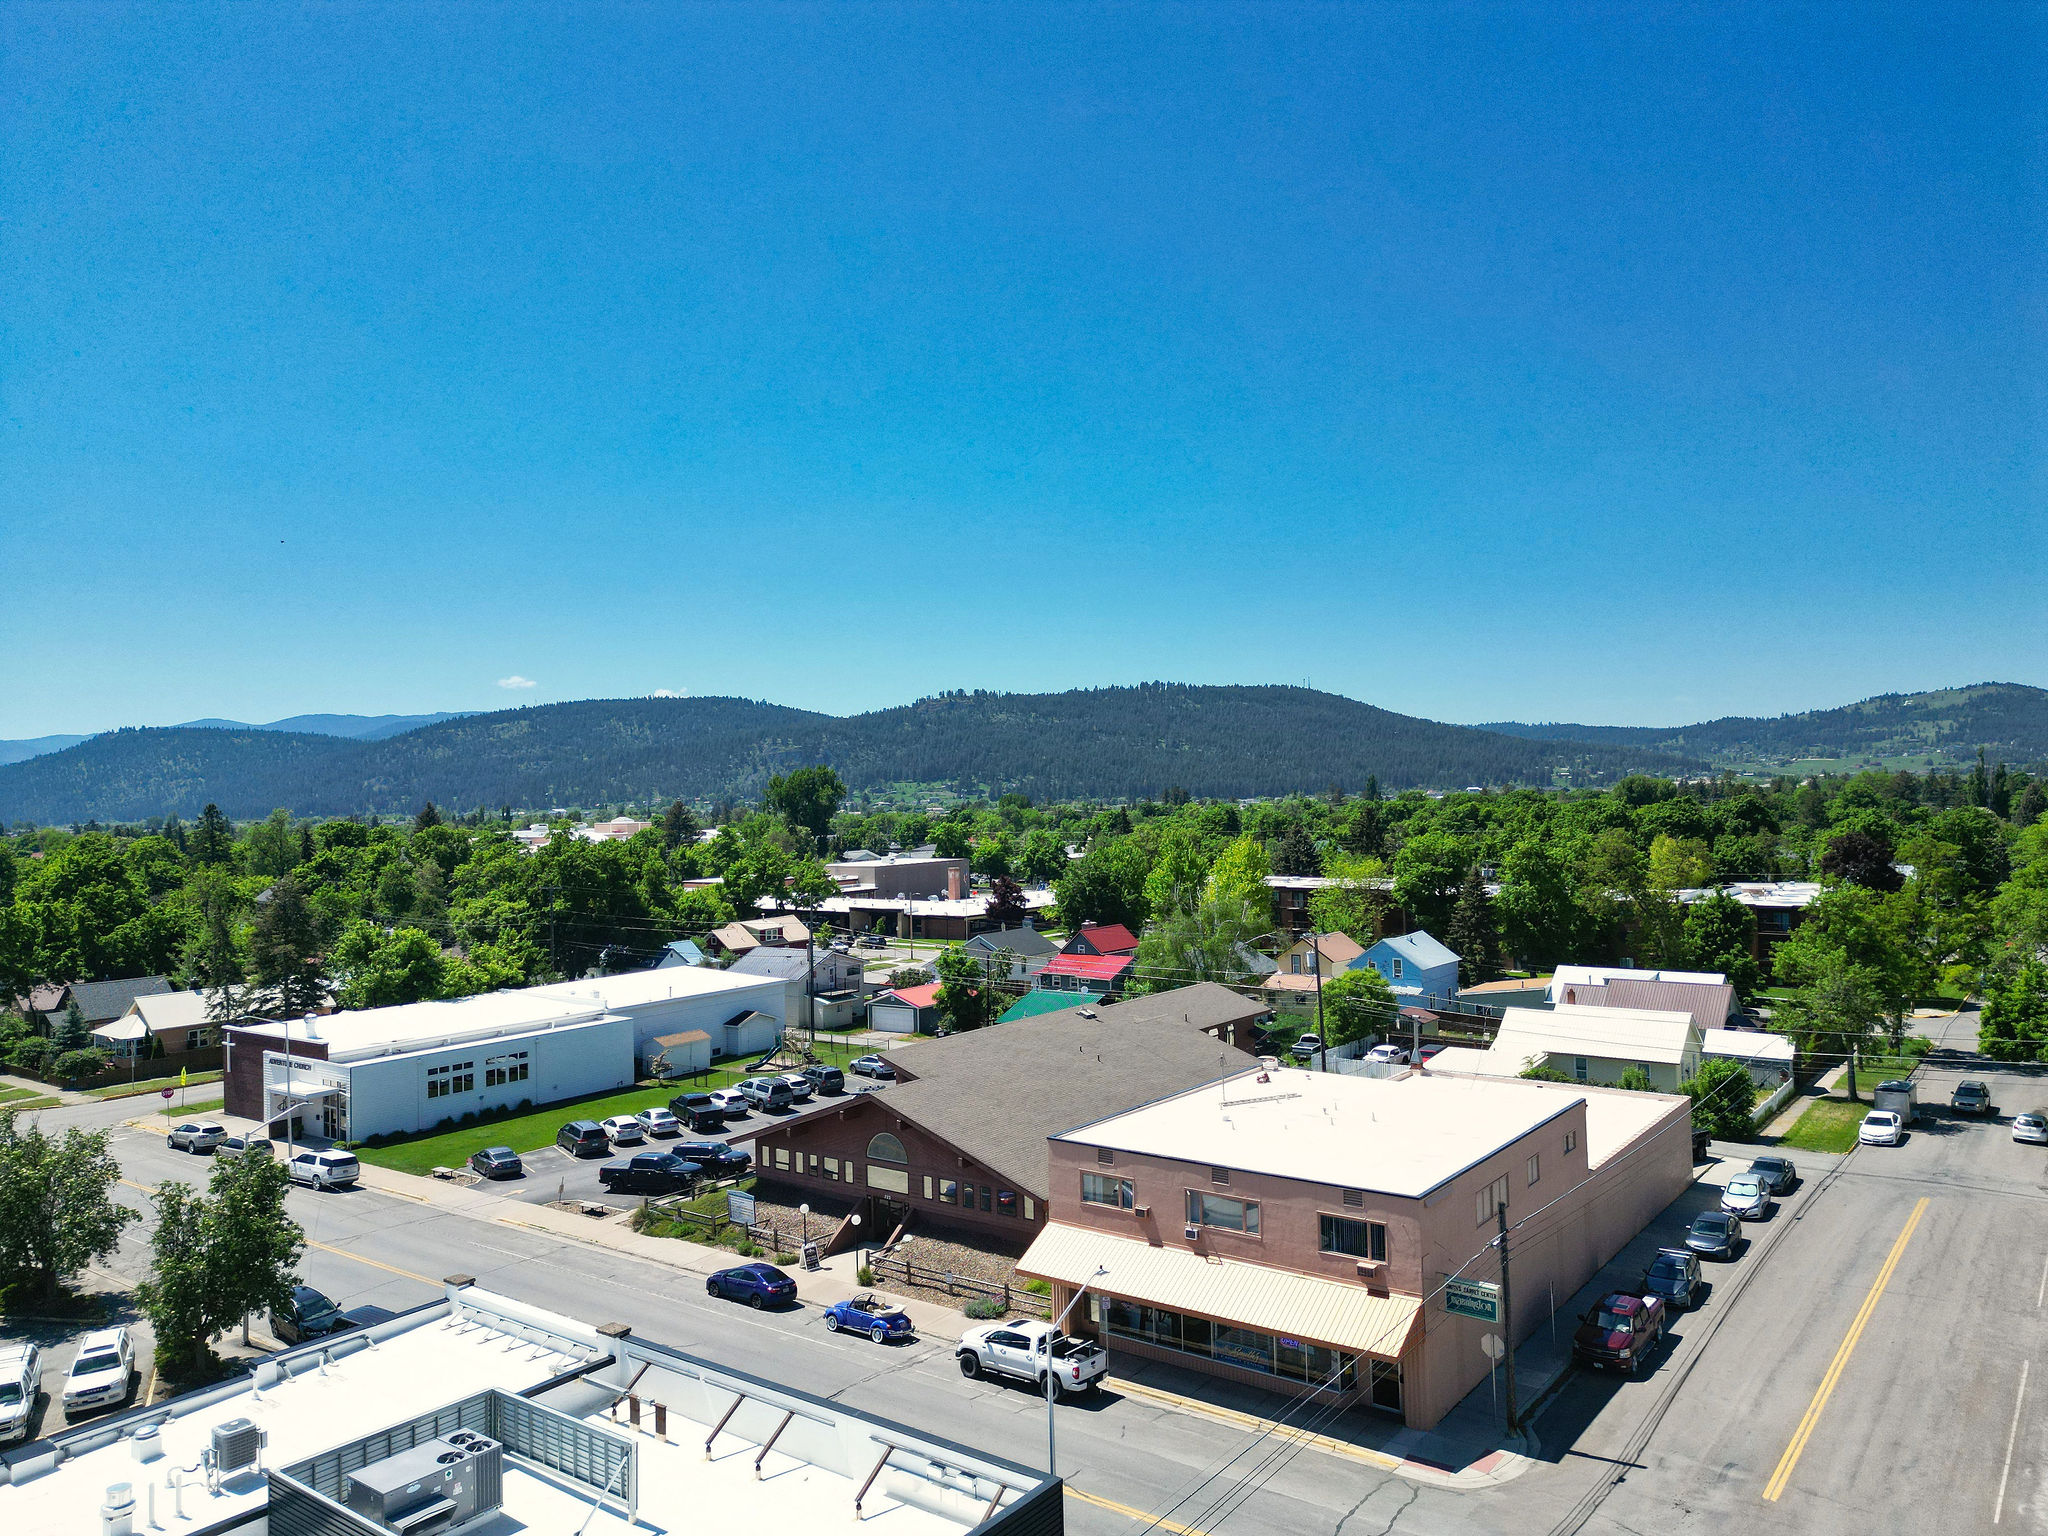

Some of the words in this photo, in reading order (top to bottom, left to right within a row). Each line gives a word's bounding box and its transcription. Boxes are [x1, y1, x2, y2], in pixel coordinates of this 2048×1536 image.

[293, 1062, 312, 1071] CHURCH
[162, 1089, 174, 1097] STOP
[1480, 1291, 1497, 1299] CENTER
[1280, 1337, 1299, 1347] OPEN
